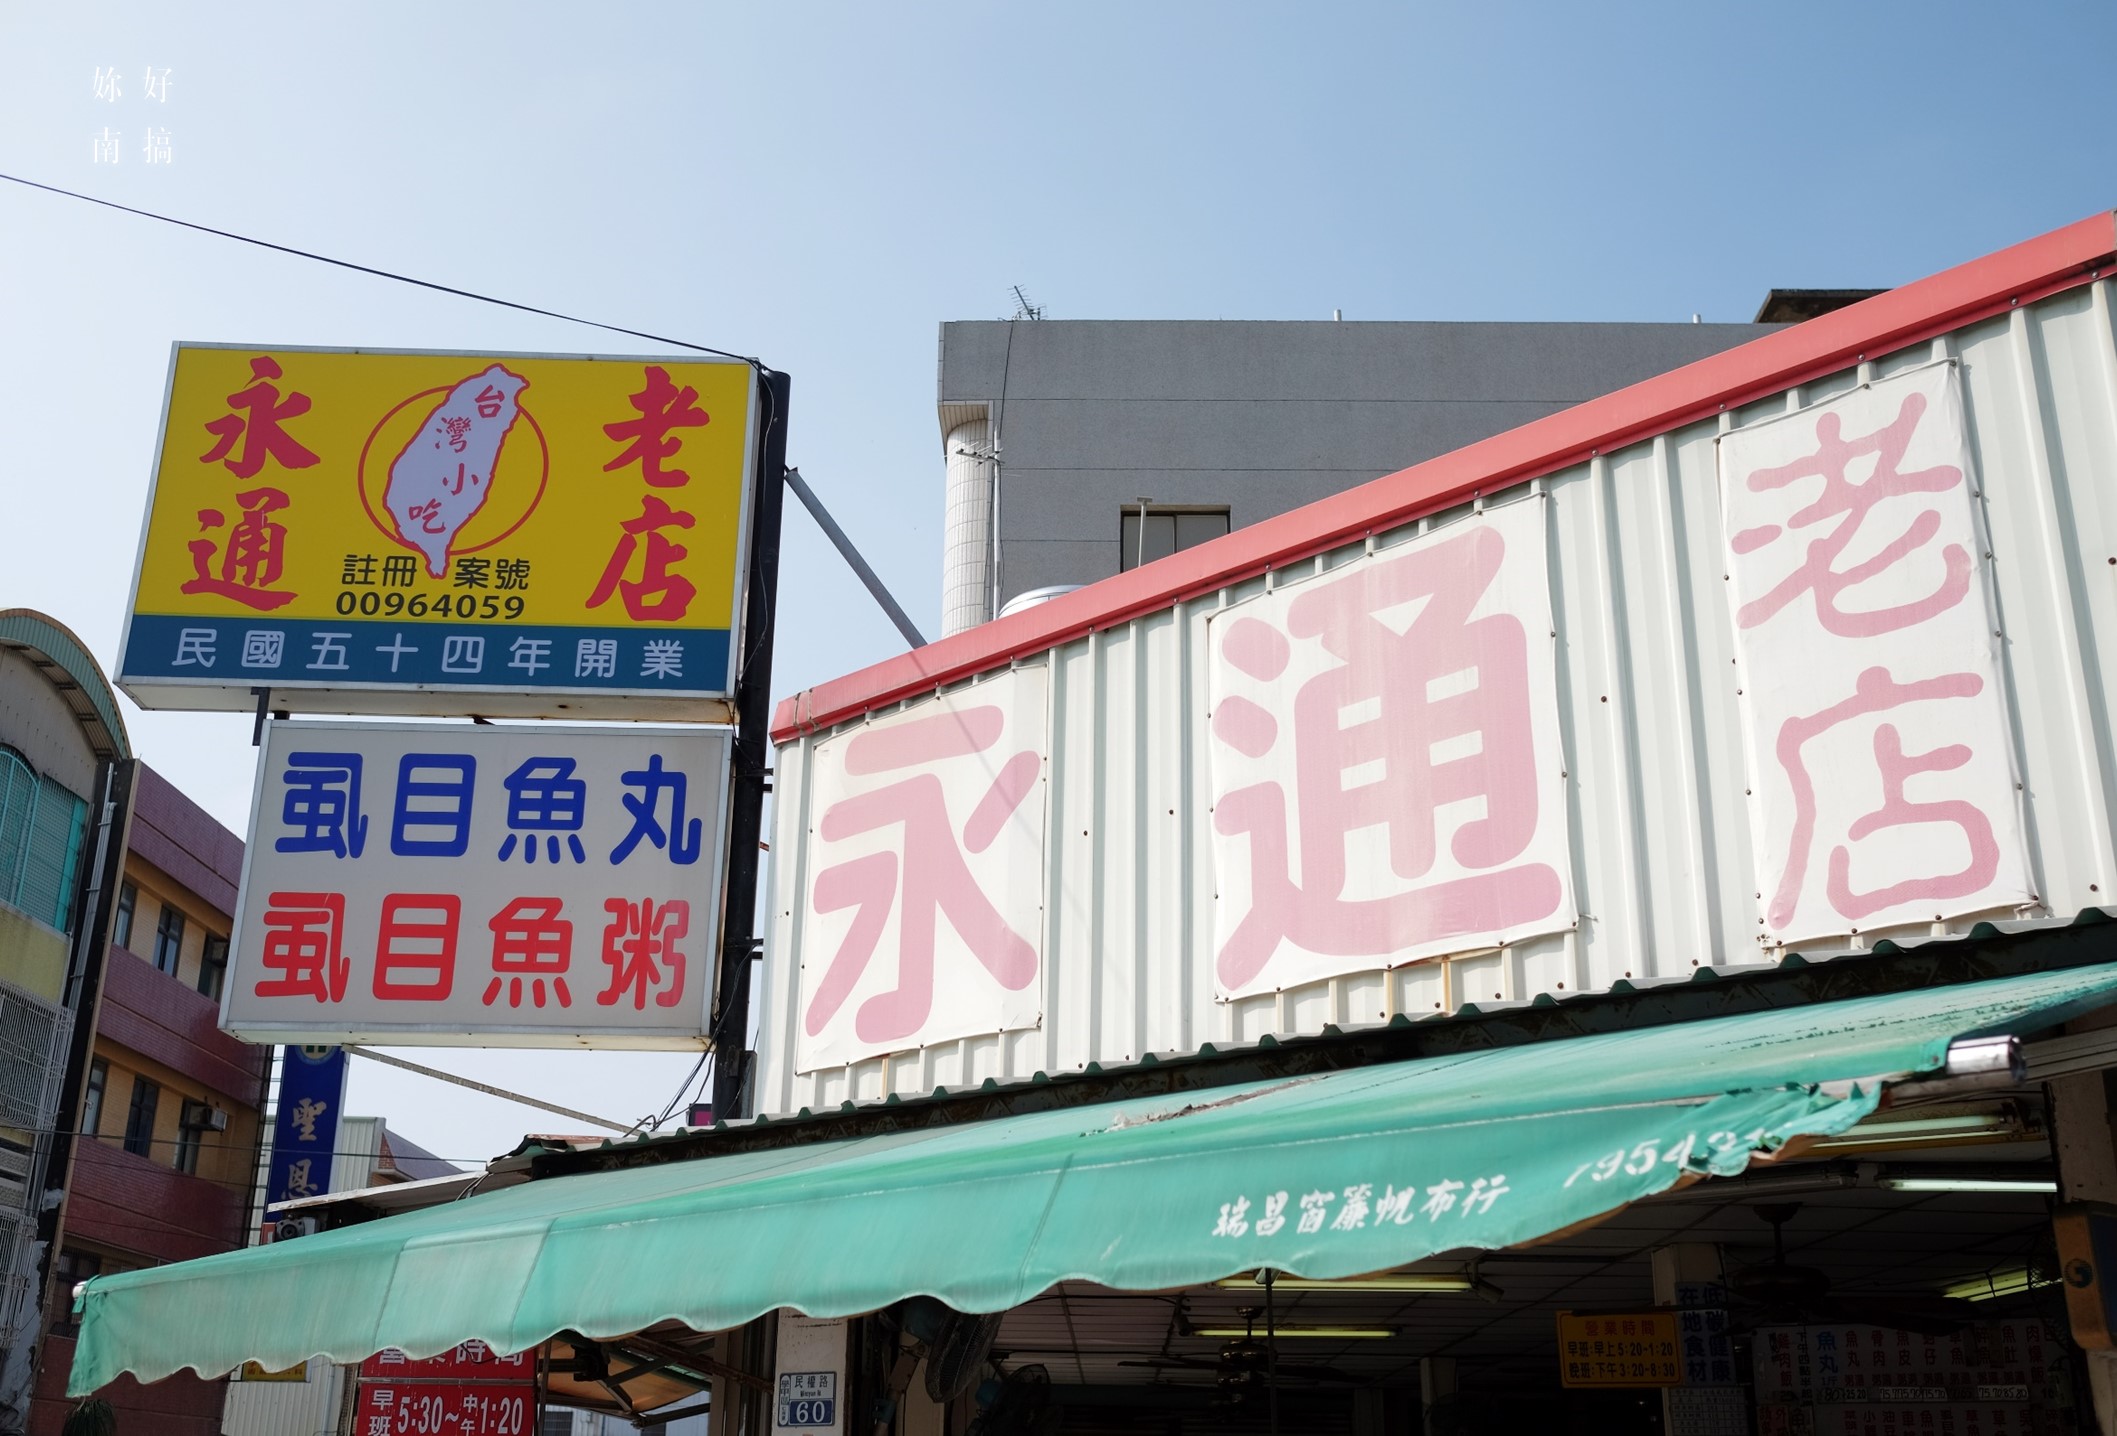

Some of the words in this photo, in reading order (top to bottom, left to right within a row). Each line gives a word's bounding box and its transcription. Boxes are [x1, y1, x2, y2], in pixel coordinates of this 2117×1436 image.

[180, 356, 320, 611] 永通
[407, 384, 506, 535] 台灣小吃
[585, 366, 710, 622] 老店
[335, 591, 525, 621] 00964059
[171, 628, 685, 680] 民國五十四年開業
[1731, 392, 2000, 929] 老店
[275, 752, 702, 866] 虱目魚丸
[254, 892, 690, 1011] 虱目魚粥
[1585, 1320, 1655, 1336] 營業時間
[1816, 1331, 1838, 1373] 魚丸
[795, 1375, 828, 1388] 民權路
[480, 1396, 523, 1435] 1:20
[796, 1401, 825, 1423] 60
